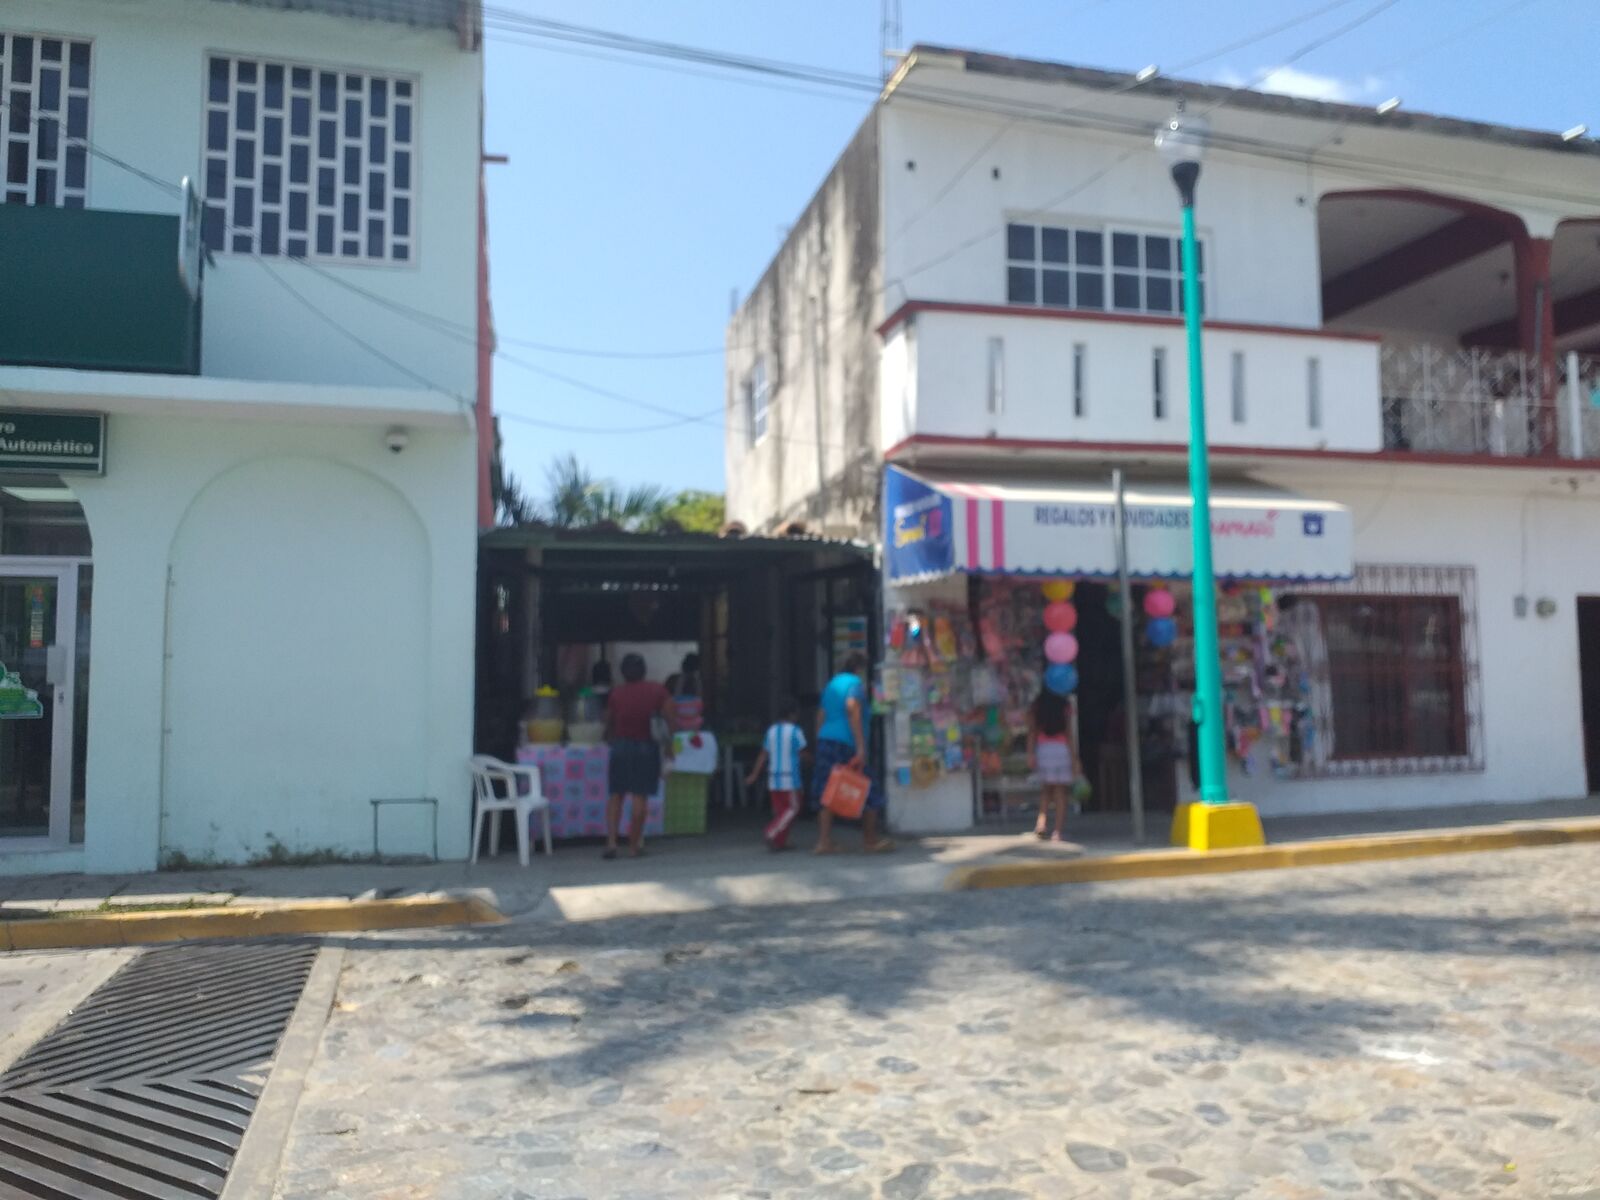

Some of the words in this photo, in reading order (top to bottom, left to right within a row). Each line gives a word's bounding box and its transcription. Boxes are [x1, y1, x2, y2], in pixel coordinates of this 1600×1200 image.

[1035, 506, 1096, 526] REGALOS
[1098, 508, 1107, 526] Y
[1110, 508, 1190, 528] NVEDADES
